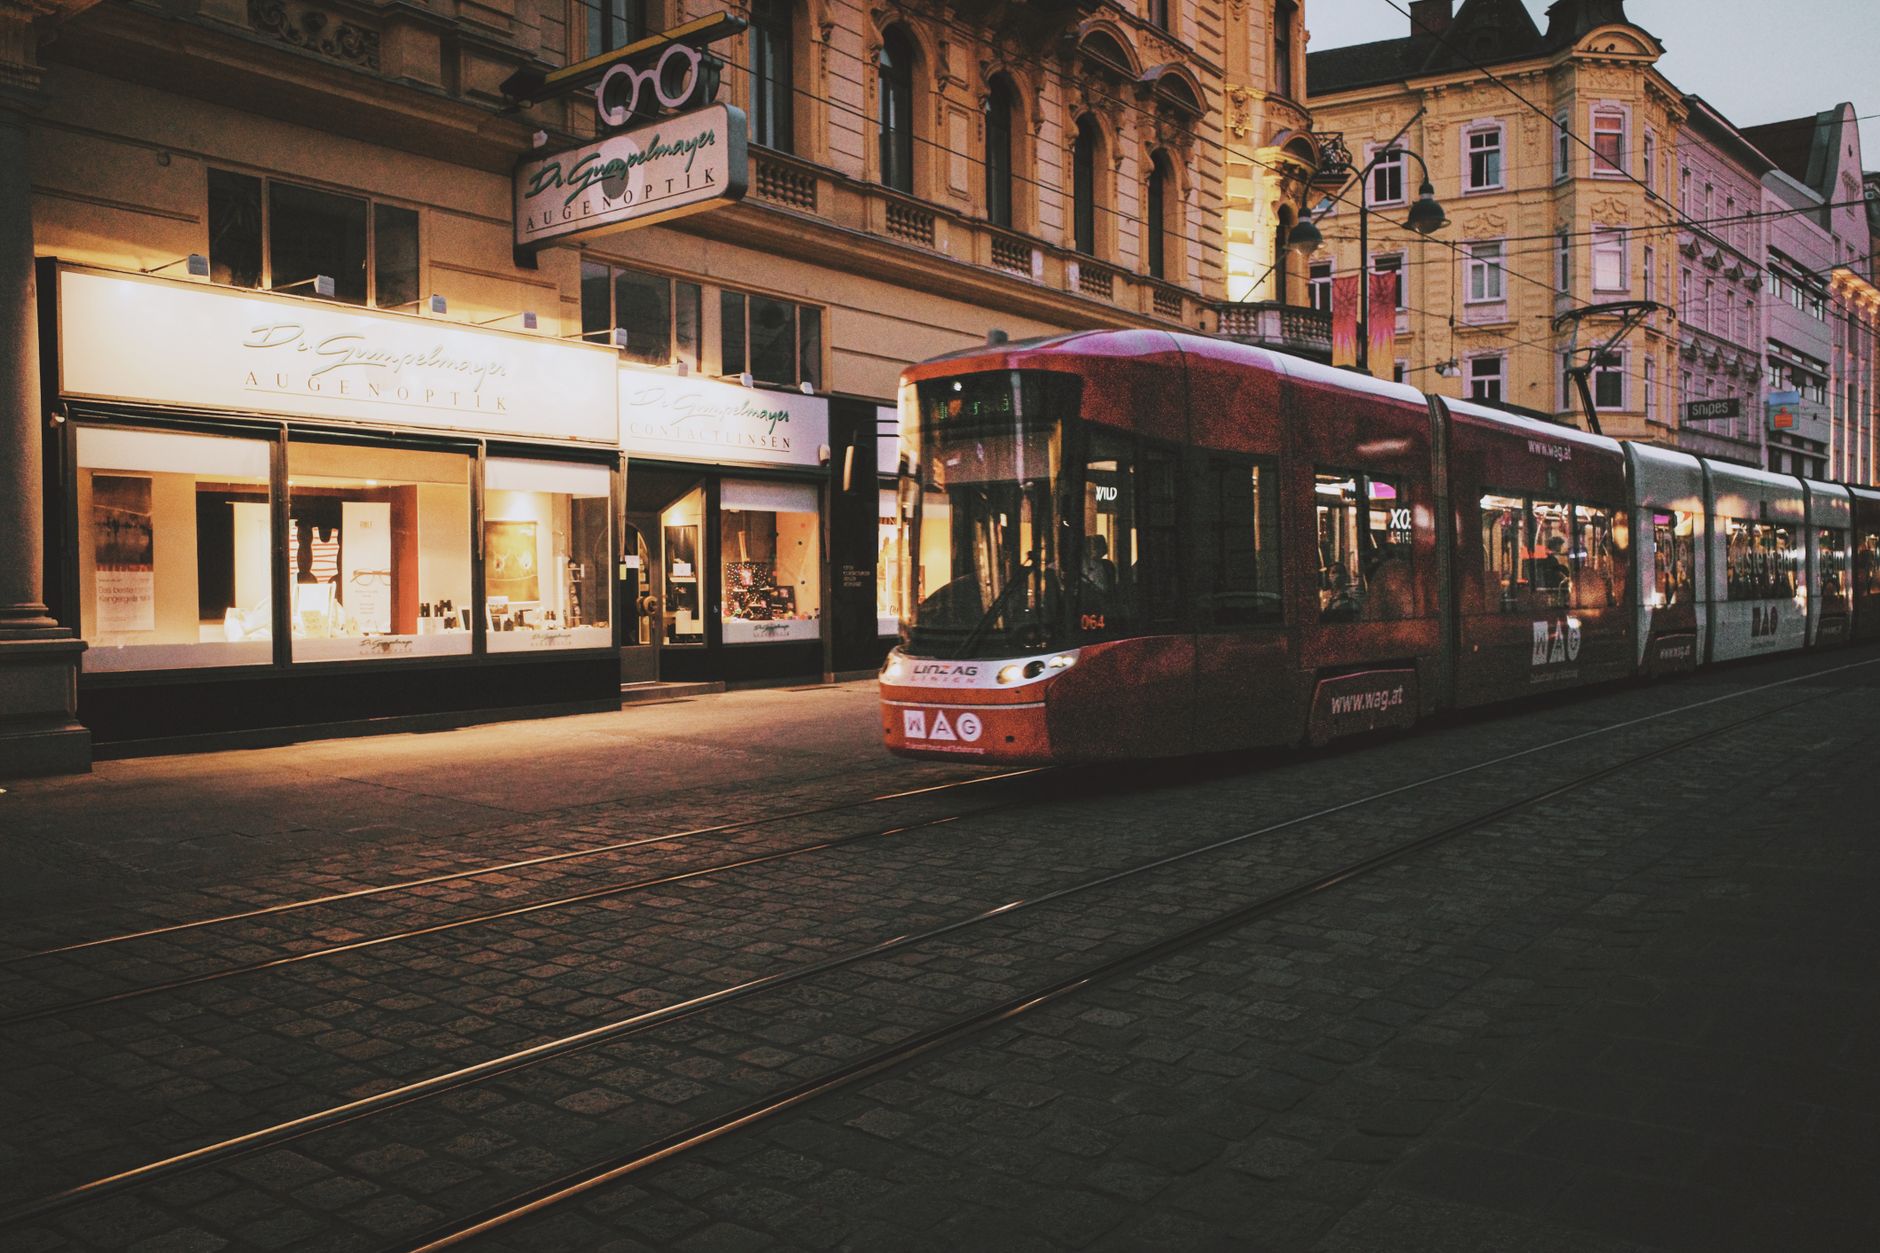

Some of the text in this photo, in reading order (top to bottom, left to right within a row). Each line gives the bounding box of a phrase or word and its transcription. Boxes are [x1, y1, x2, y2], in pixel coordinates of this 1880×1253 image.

[525, 168, 716, 230] AUGENOPTIK
[311, 332, 507, 393] Gumpelmayer
[244, 370, 507, 412] AUGENOPTIK
[1691, 401, 1729, 417] snipes
[629, 421, 792, 449] CONTACTLINSEN
[1527, 439, 1572, 462] www.wag.at
[949, 665, 979, 677] AG
[1331, 684, 1404, 714] www.wag.at
[907, 714, 978, 737] WAG
